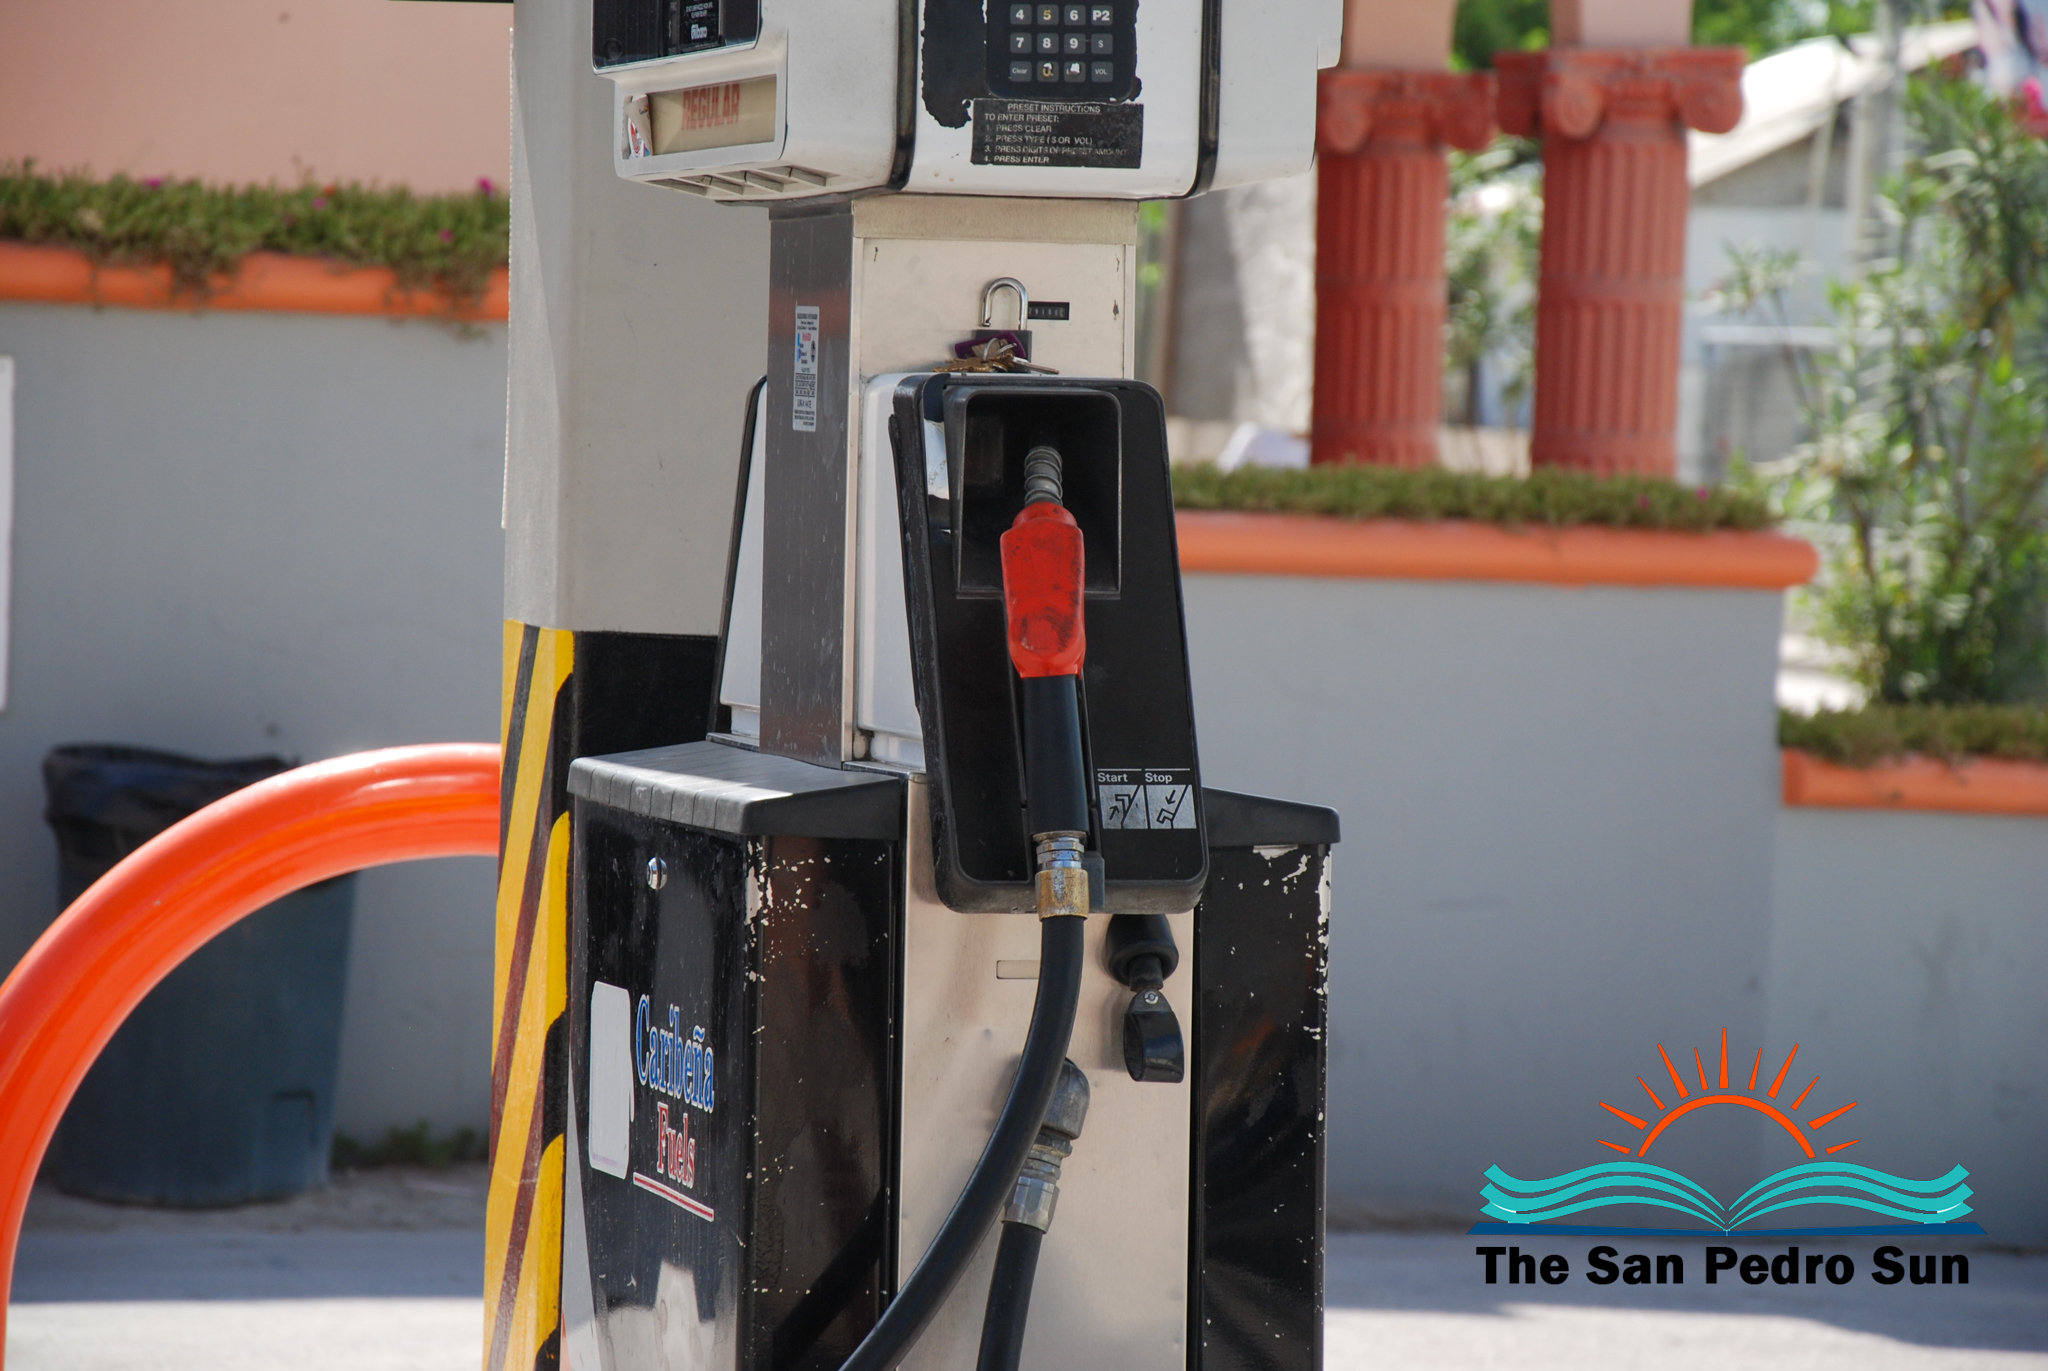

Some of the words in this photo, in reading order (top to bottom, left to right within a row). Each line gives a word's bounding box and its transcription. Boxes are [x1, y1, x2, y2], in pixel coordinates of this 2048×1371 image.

[1015, 9, 1024, 20] 4
[1043, 9, 1052, 20] 5
[1069, 9, 1079, 20] 6
[1092, 10, 1110, 21] P2
[1015, 37, 1024, 48] 7
[1042, 37, 1051, 48] 8
[1069, 38, 1078, 49] 9
[681, 82, 740, 130] REGULAR
[1007, 103, 1039, 111] PRESET
[1041, 104, 1101, 113] INSTRUCTIONS
[984, 113, 996, 121] TO
[1026, 114, 1060, 123] PRESET:
[996, 124, 1023, 132] PRESS
[1024, 125, 1052, 133] CLEAR
[996, 135, 1023, 143] PRESS
[1024, 135, 1045, 143] TYPE
[995, 145, 1021, 153] PRESS
[994, 155, 1021, 163] PRESS
[1022, 156, 1050, 164] ENTER
[1097, 772, 1128, 783] Start
[1144, 772, 1173, 784] Stop
[636, 994, 715, 1113] Caribeña
[657, 1101, 696, 1189] Fuels
